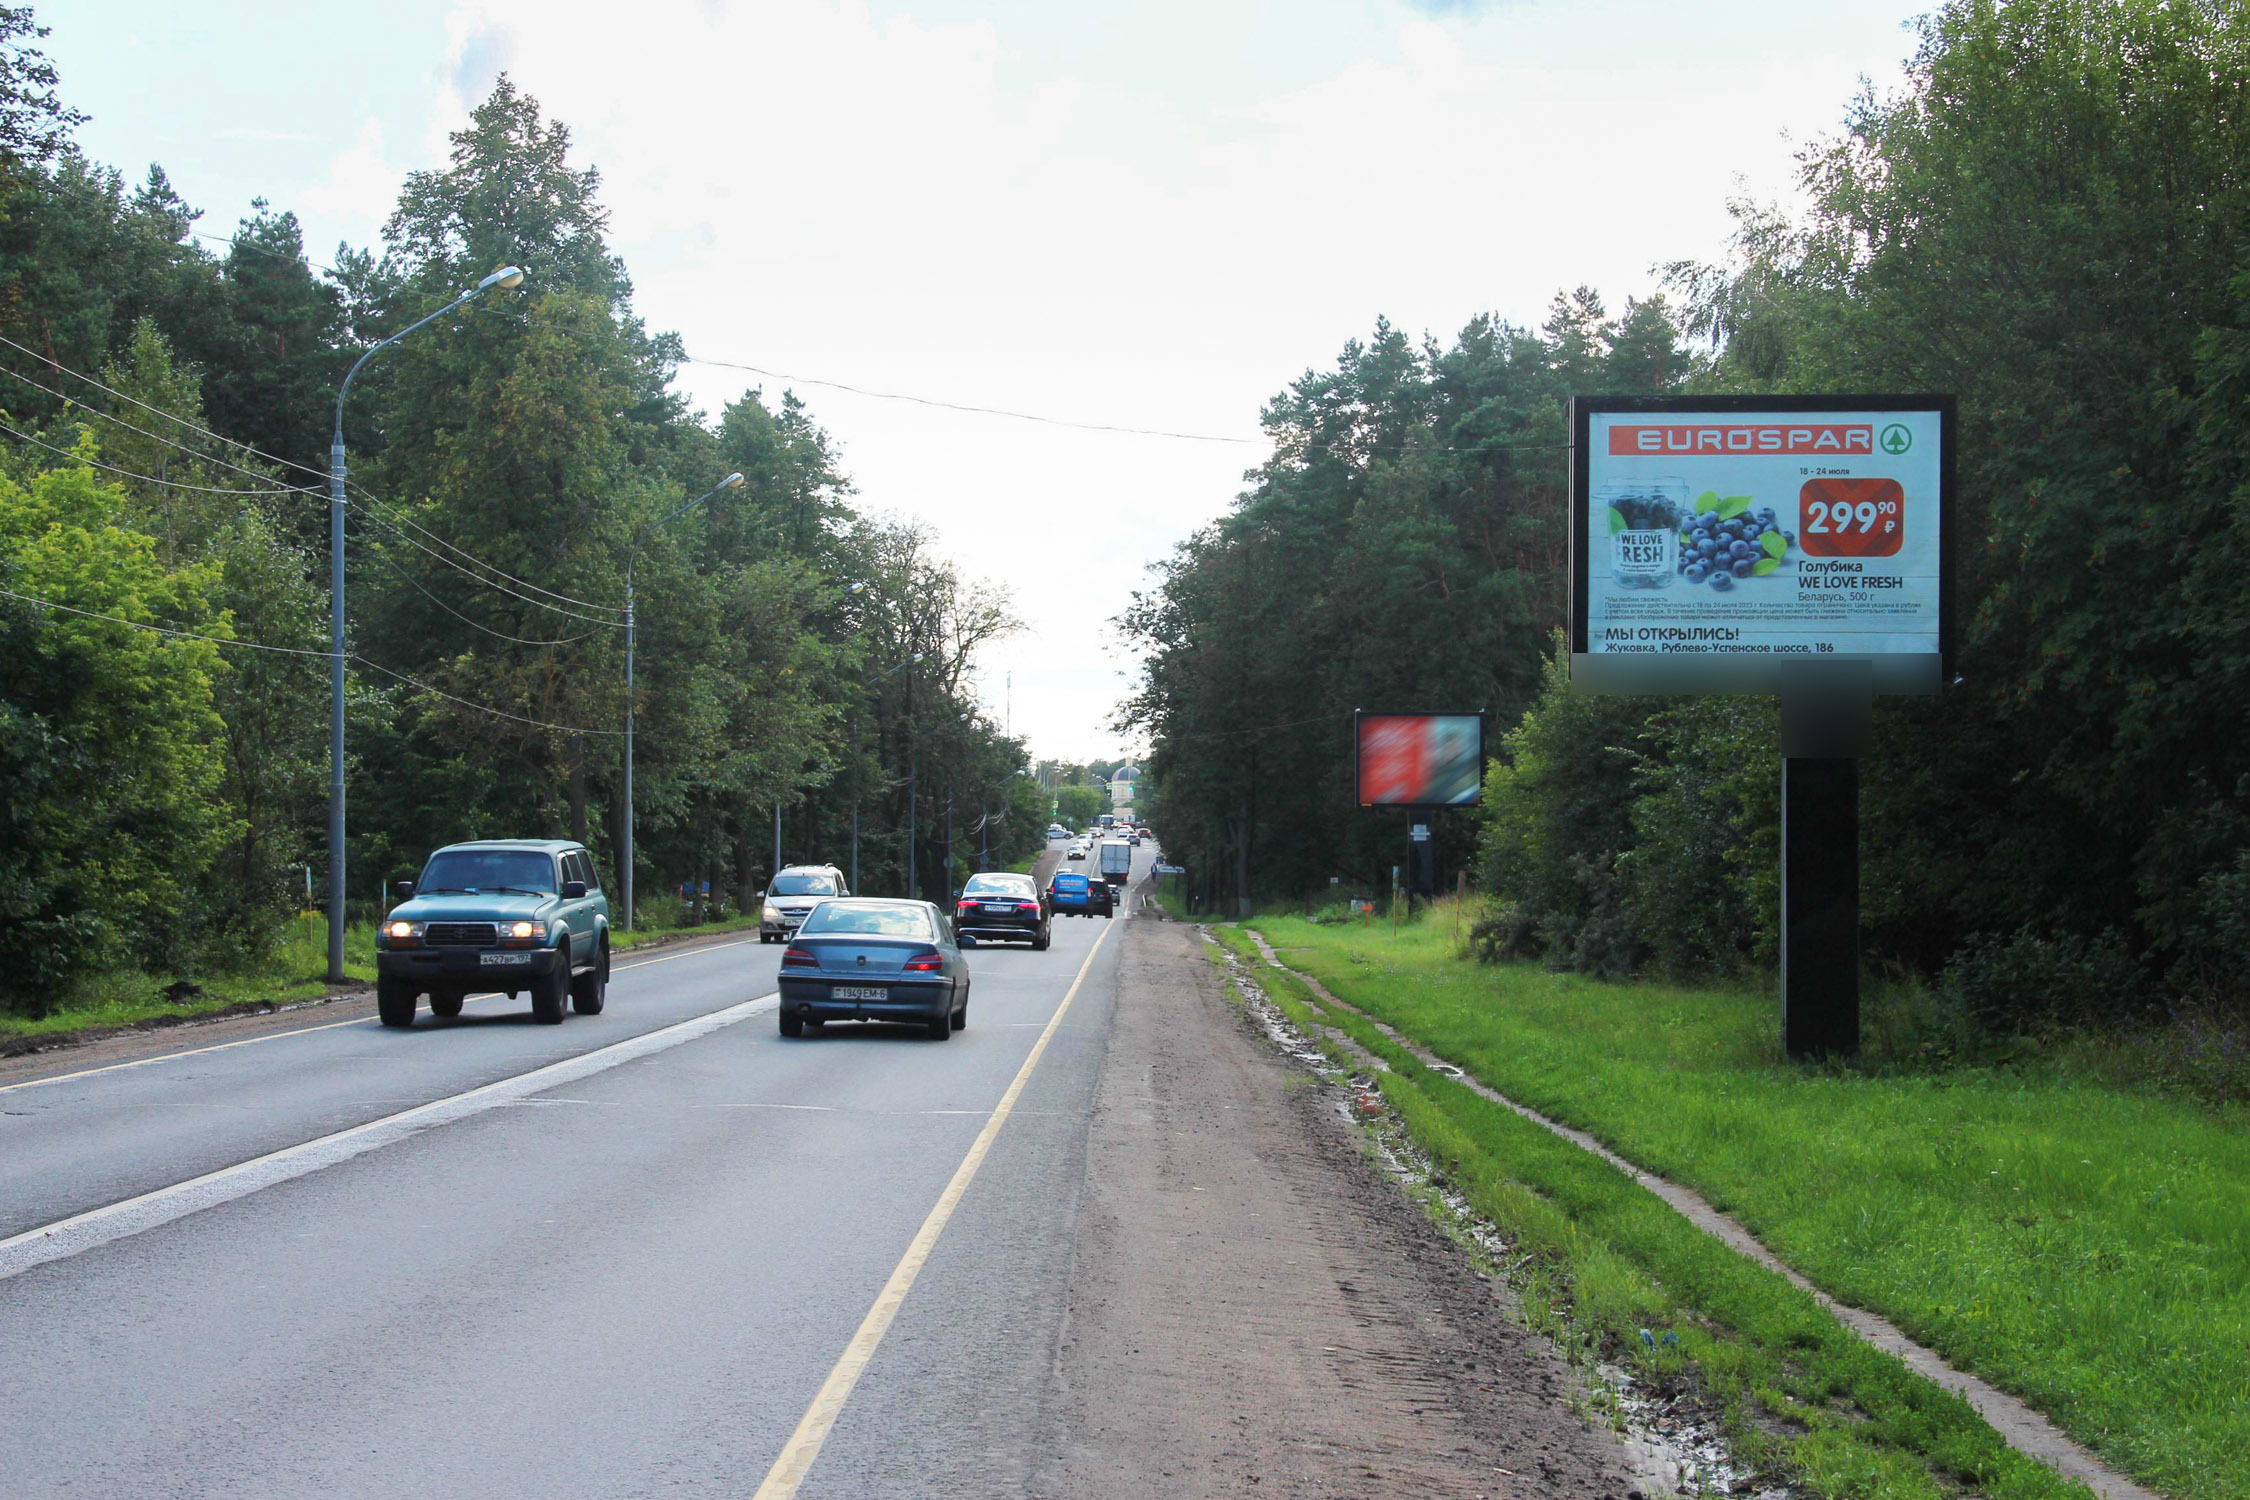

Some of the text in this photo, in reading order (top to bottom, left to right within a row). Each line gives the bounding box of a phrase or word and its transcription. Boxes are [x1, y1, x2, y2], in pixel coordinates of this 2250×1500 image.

[1637, 428, 1871, 451] EUROSPAR
[1799, 467, 1808, 475] 18
[1816, 467, 1827, 475] 24
[1807, 501, 1877, 534] 299
[1621, 534, 1663, 545] WE LOVE
[1798, 560, 1863, 575] Голубика
[1798, 576, 1903, 589] WE LOVE FRESH
[1798, 592, 1847, 603] Беларусь,
[1849, 592, 1868, 602] 500
[1605, 627, 1633, 640] МЫ
[1638, 627, 1739, 640] ОТКРЫЛИСЬ!
[1605, 642, 1834, 653] Жуковка, Рублево-Успенское шоссе, 186
